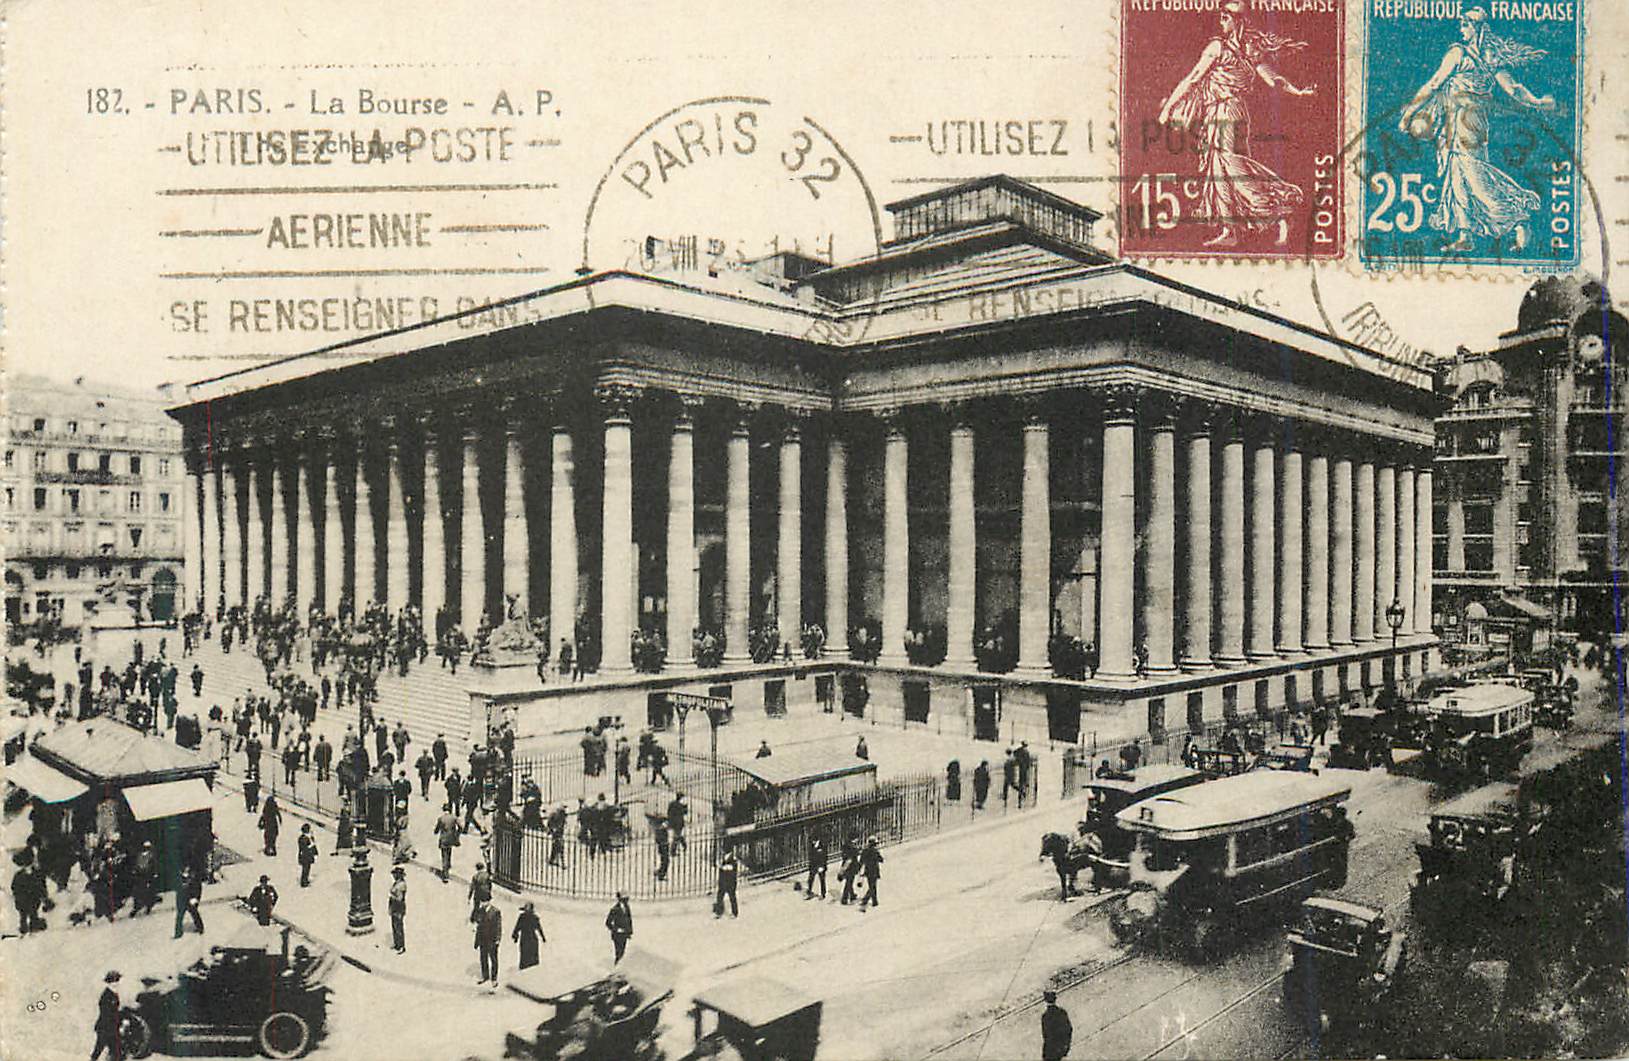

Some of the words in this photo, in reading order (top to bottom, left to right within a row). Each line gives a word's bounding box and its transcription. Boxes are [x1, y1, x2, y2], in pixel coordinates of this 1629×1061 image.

[1373, 1, 1464, 20] REPUBLIQUE
[1490, 1, 1574, 21] FRANÇAISE
[1314, 153, 1335, 244] POSTES
[1550, 160, 1572, 250] POSTES
